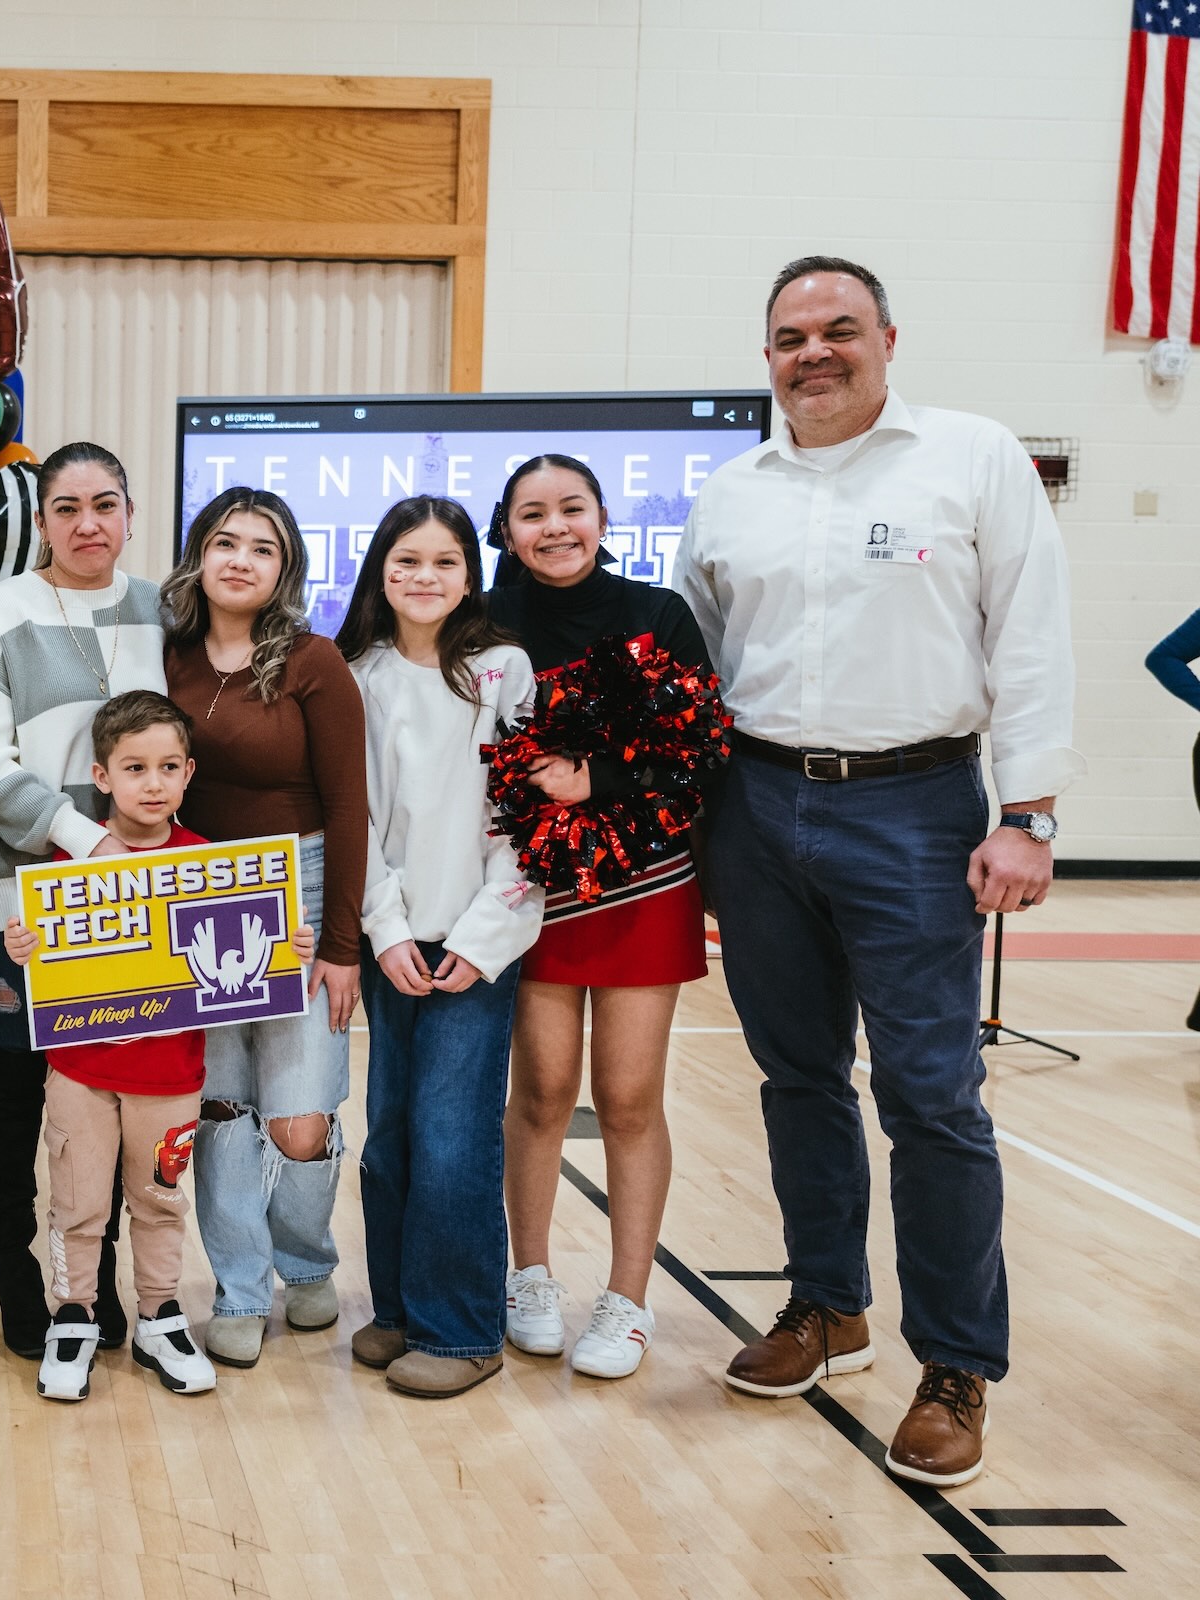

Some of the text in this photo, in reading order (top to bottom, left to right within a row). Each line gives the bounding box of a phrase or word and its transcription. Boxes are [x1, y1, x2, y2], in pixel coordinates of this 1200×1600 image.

[205, 453, 711, 498] TENNEEE
[33, 851, 288, 912] TENNESSEE
[36, 904, 151, 948] TECH
[53, 996, 171, 1033] Live Wings Up!
